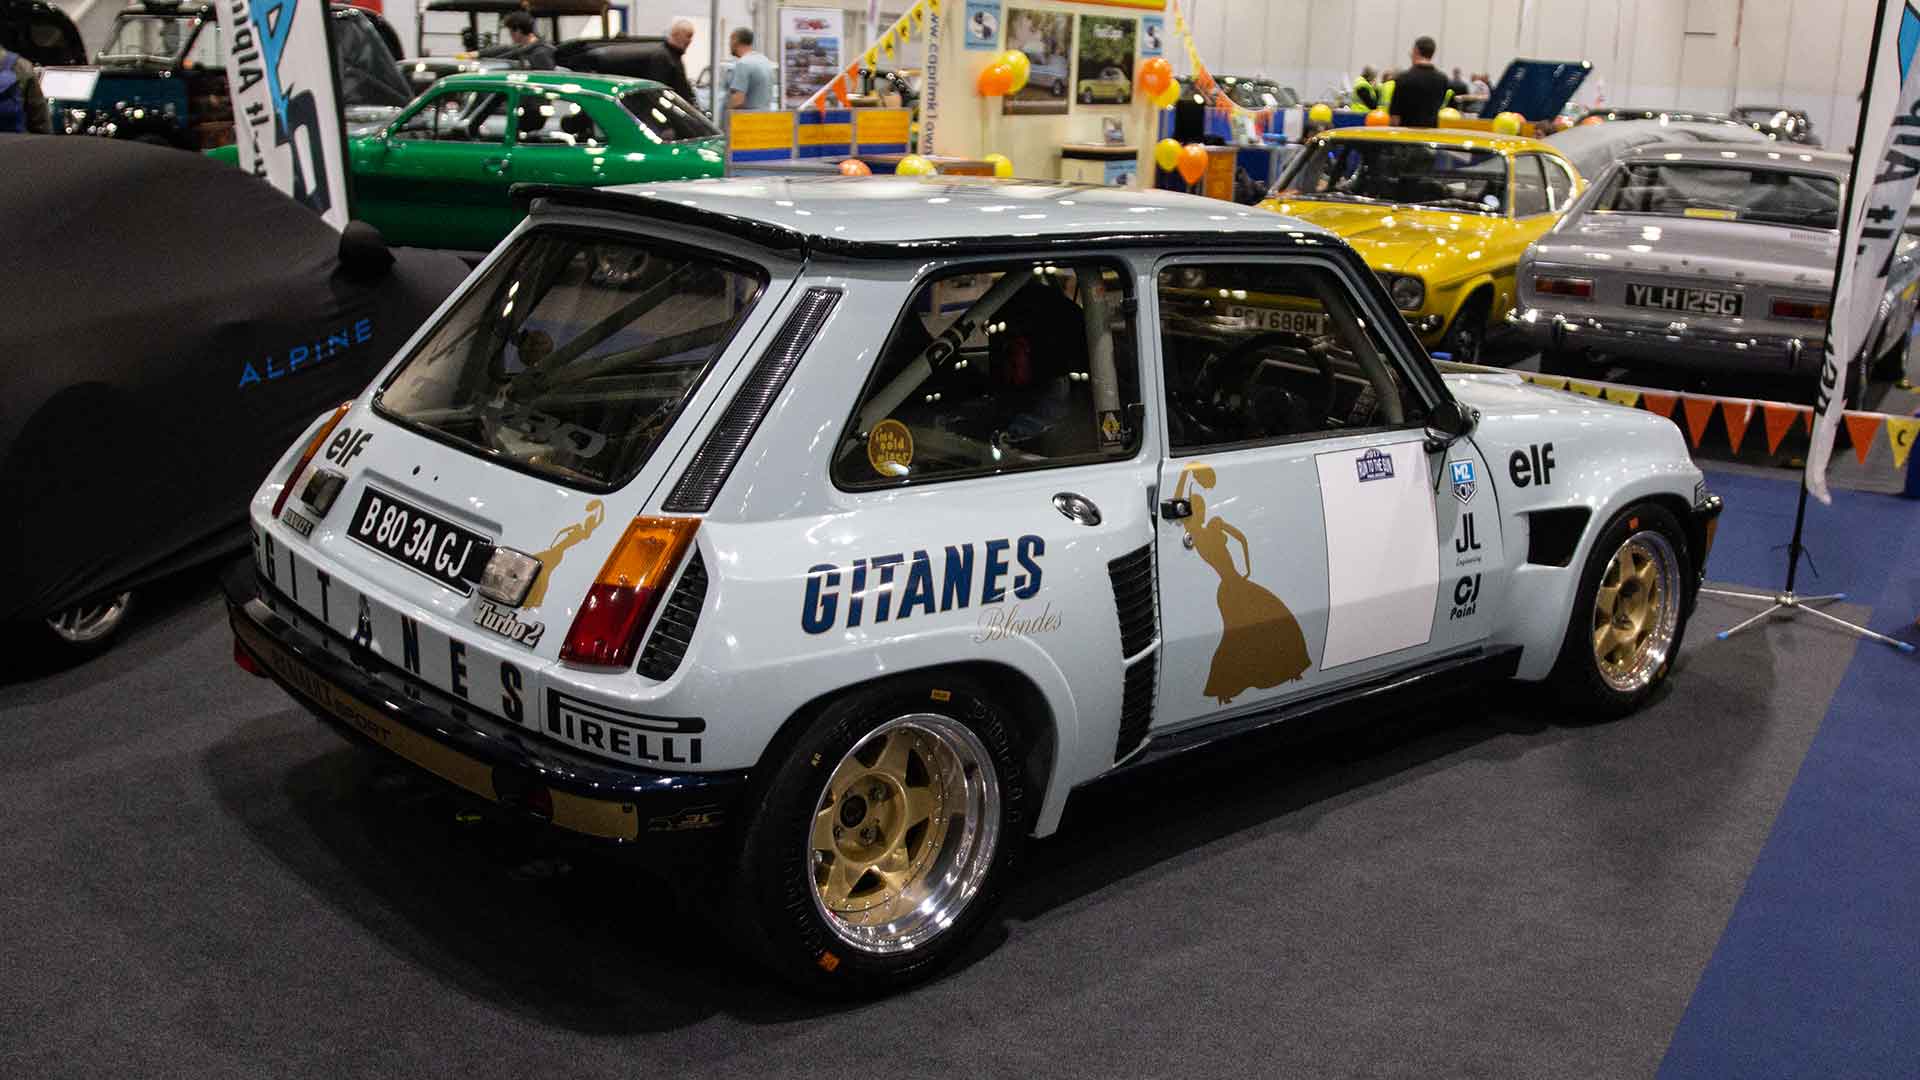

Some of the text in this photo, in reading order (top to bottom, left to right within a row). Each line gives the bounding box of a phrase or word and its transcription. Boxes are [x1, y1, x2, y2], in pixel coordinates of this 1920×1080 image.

[239, 319, 373, 387] ALPINE
[325, 427, 374, 468] elf
[1509, 442, 1556, 488] elf
[1455, 512, 1481, 553] JL
[801, 534, 1045, 635] GITANES
[264, 531, 524, 723] GITANES
[974, 602, 1063, 643] Blondes
[1450, 602, 1476, 620] Paint
[546, 687, 706, 764] PIRELLI
